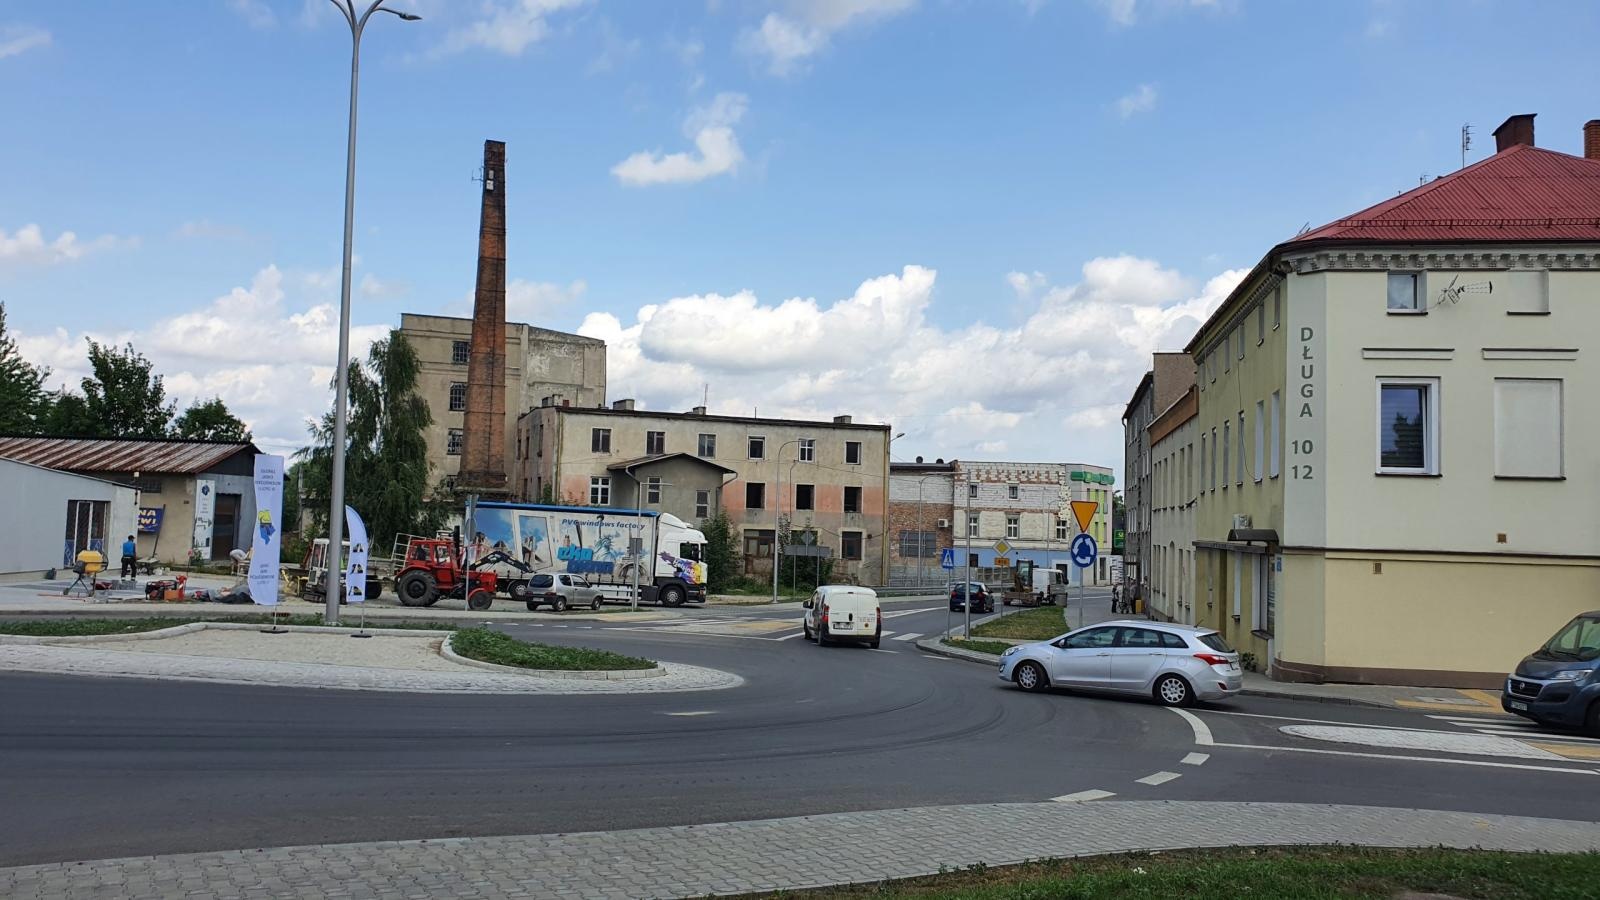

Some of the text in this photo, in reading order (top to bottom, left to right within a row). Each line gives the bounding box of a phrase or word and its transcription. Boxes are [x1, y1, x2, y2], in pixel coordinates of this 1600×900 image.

[1299, 327, 1314, 418] DŁUGA
[1291, 439, 1314, 455] 10
[1291, 464, 1314, 480] 12
[580, 519, 615, 528] windows
